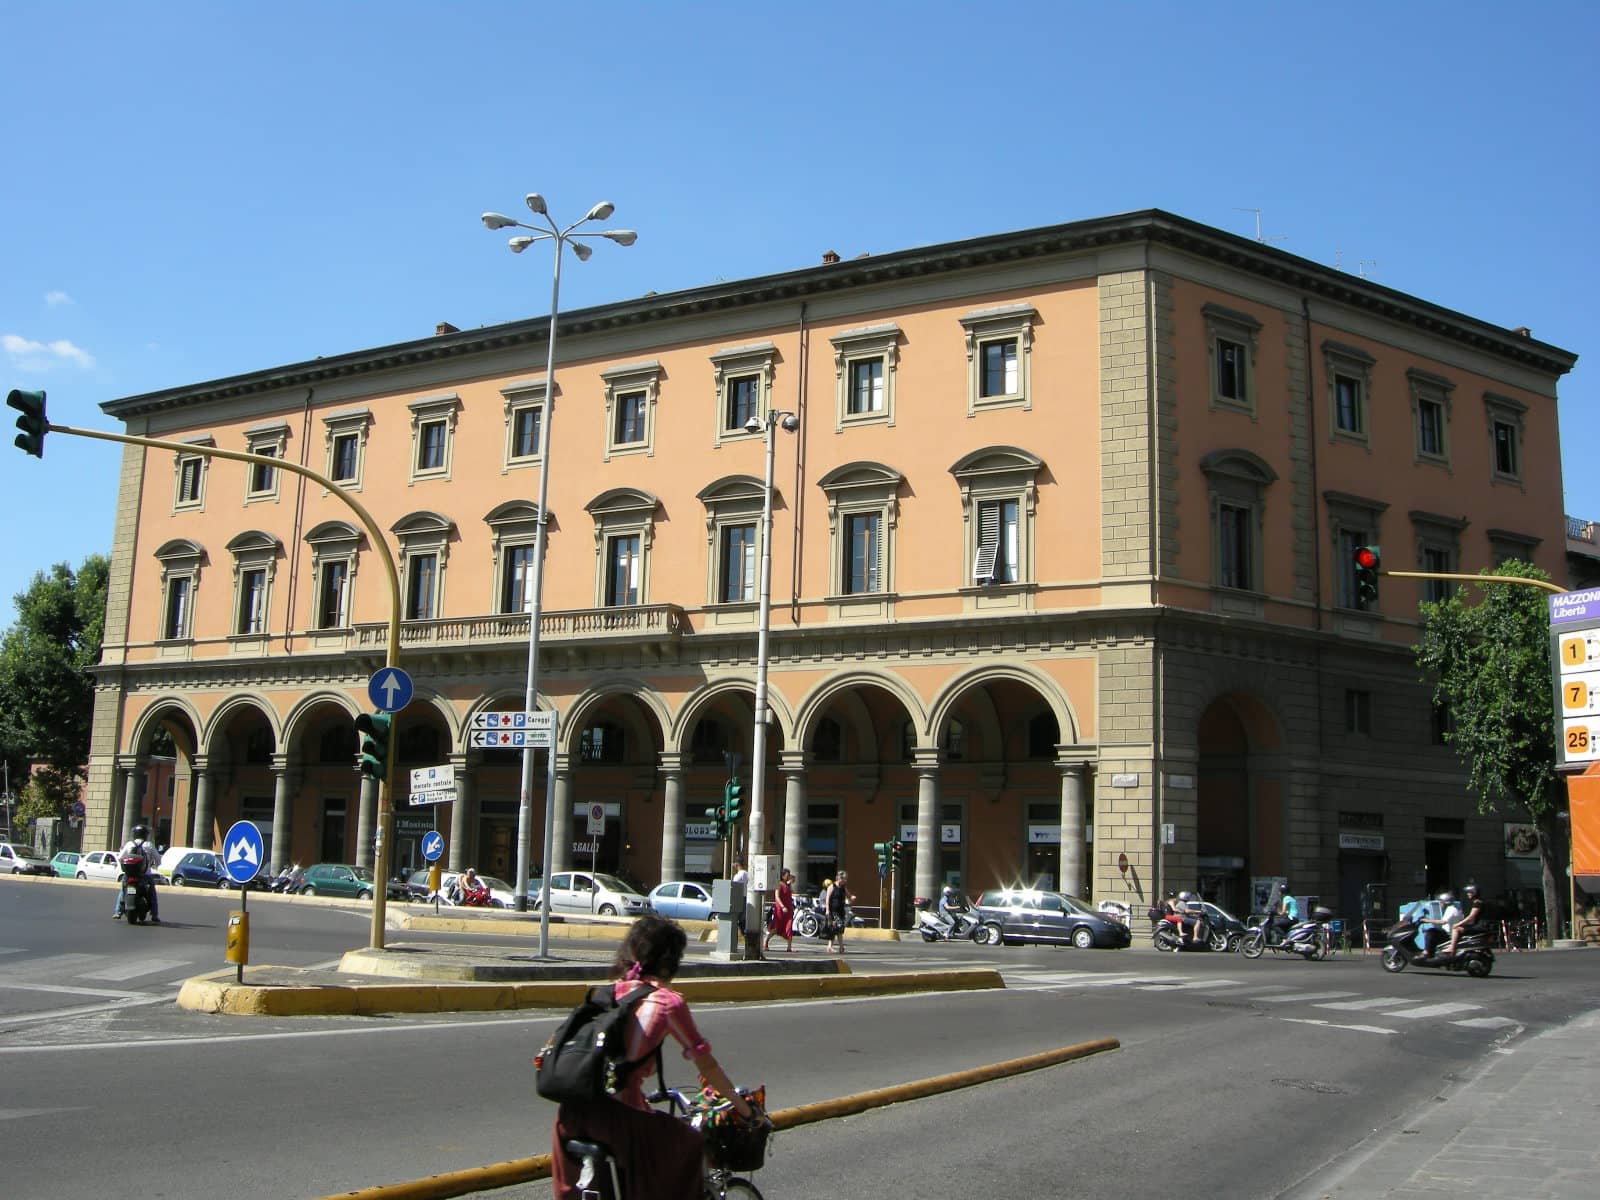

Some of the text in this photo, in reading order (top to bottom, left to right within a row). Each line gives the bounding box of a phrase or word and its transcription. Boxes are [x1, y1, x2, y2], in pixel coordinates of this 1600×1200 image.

[1553, 605, 1586, 618] Libertà
[1569, 644, 1576, 658] 1
[1570, 687, 1580, 702] 7
[1568, 731, 1588, 747] 25
